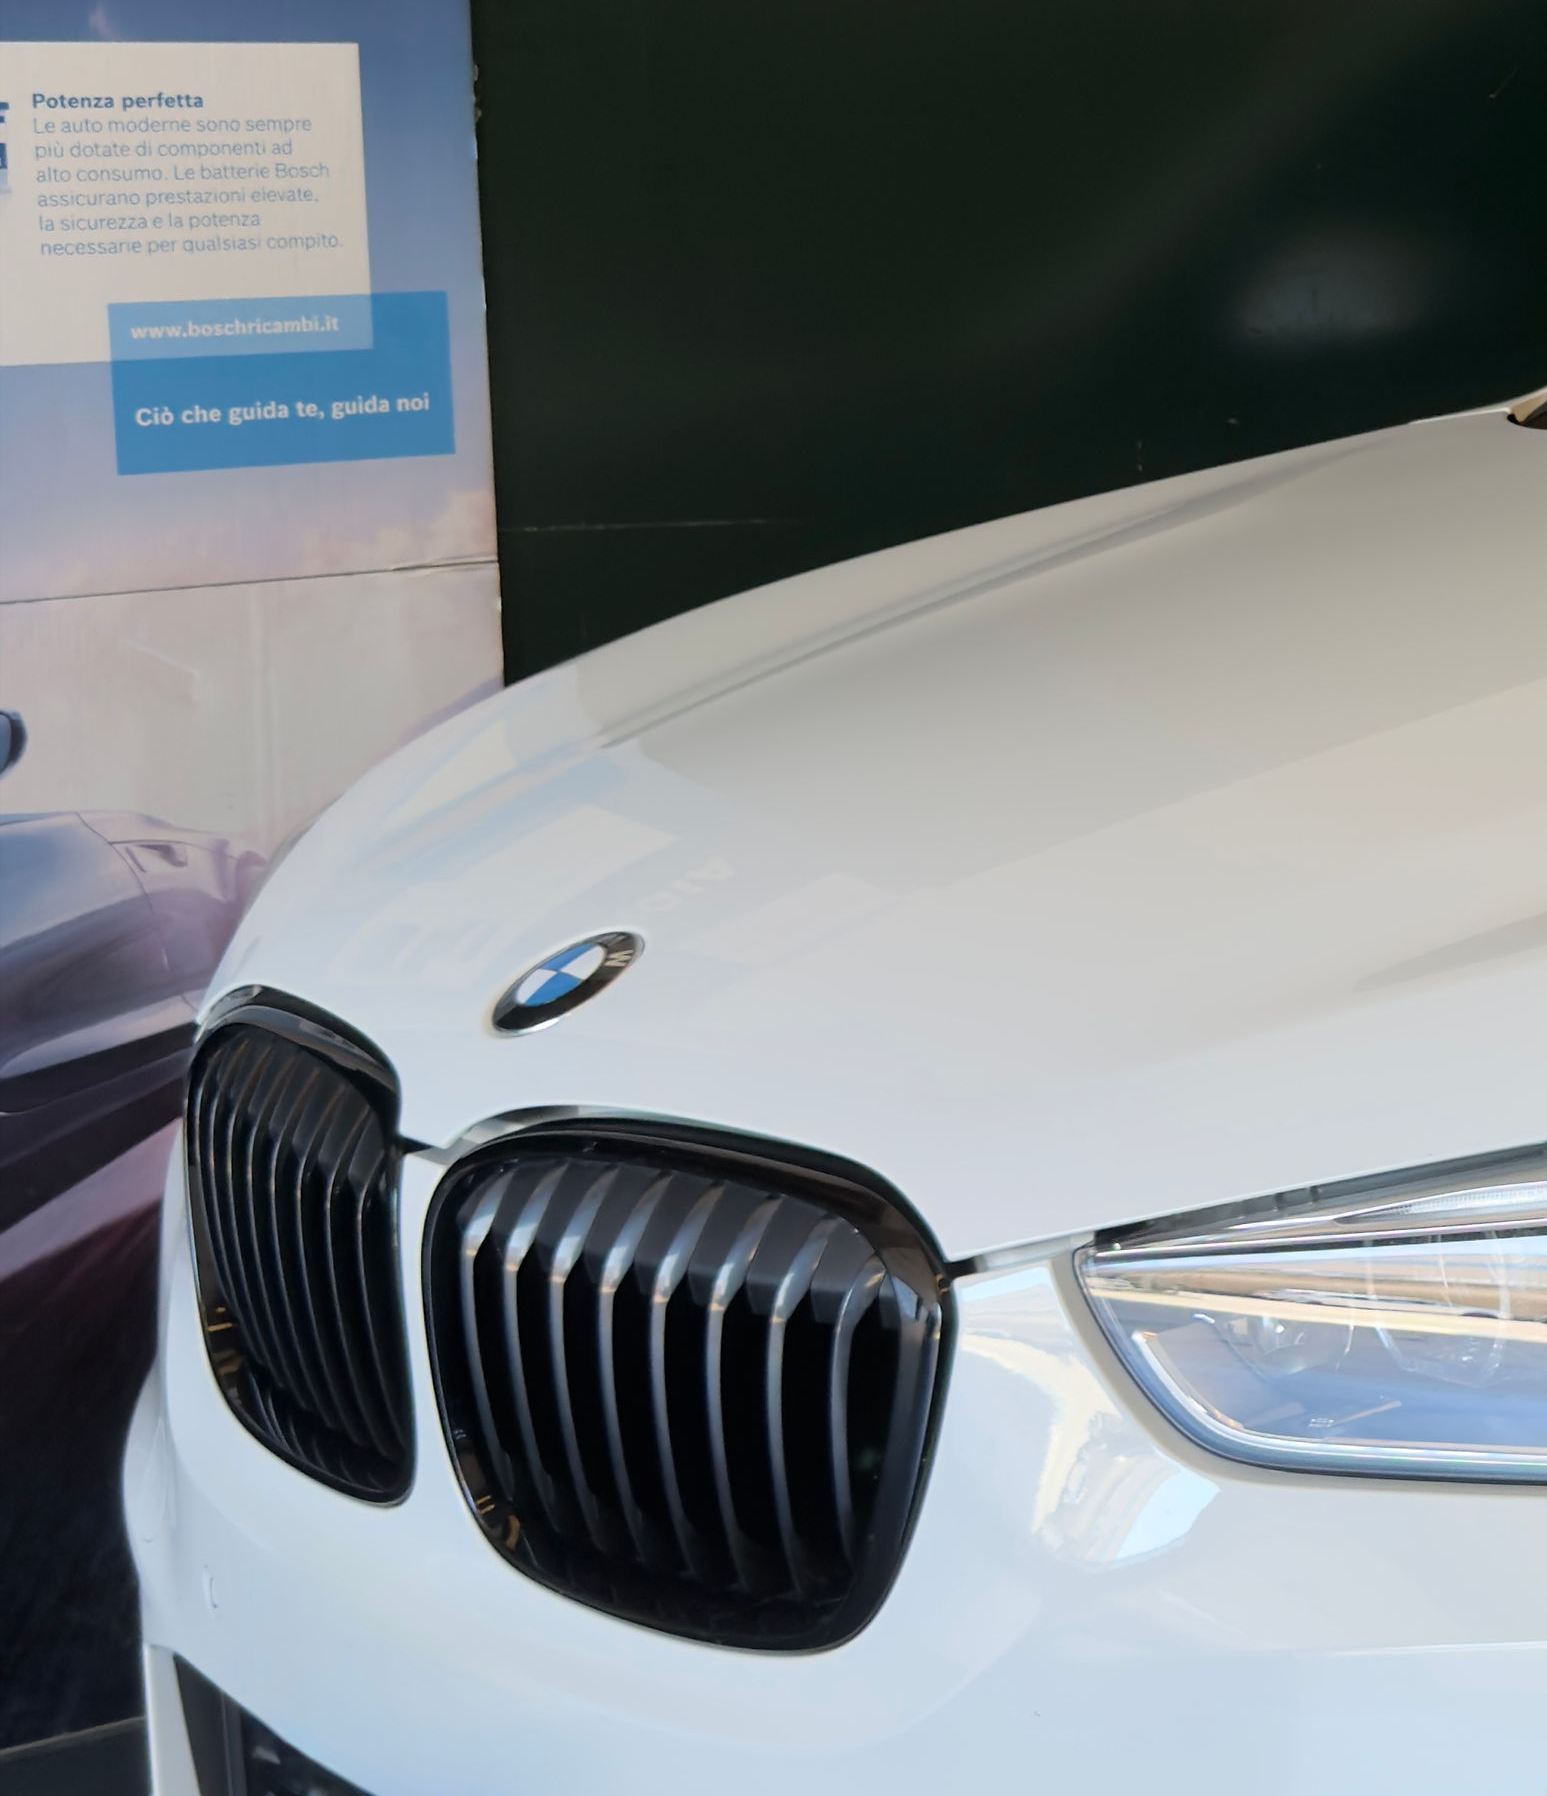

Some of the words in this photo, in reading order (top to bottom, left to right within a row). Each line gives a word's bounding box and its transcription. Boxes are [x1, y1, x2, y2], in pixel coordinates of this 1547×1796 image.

[32, 93, 115, 109] Potenza
[122, 92, 204, 112] perfetta
[33, 117, 56, 134] Le
[60, 118, 103, 134] auto
[108, 116, 191, 133] moderne
[196, 118, 241, 132] sono
[245, 118, 312, 135] sempre
[35, 141, 64, 160] più
[69, 141, 131, 158] dotate
[135, 141, 153, 157] di
[158, 140, 267, 159] componenti
[271, 139, 293, 156] ad
[36, 167, 72, 183] alto
[76, 168, 169, 183] consumo.
[173, 164, 196, 181] Le
[201, 163, 270, 181] batterie
[274, 162, 330, 179] Bosch
[37, 191, 141, 208] assicurano
[146, 188, 246, 207] prestazioni
[39, 215, 55, 232] la
[60, 215, 148, 231] sicurezza
[152, 215, 164, 230] e
[168, 213, 184, 229] la
[188, 212, 261, 231] potenza
[41, 239, 143, 256] necessarie
[147, 239, 177, 257] per
[182, 233, 262, 254] qualsiasi
[266, 232, 344, 252] compito.
[130, 315, 339, 340] www.boschricambi.it
[135, 405, 174, 427] Ciò
[181, 403, 222, 424] che
[228, 401, 290, 425] guida
[296, 400, 325, 420] te,
[331, 394, 390, 419] guida
[396, 392, 430, 411] noi
